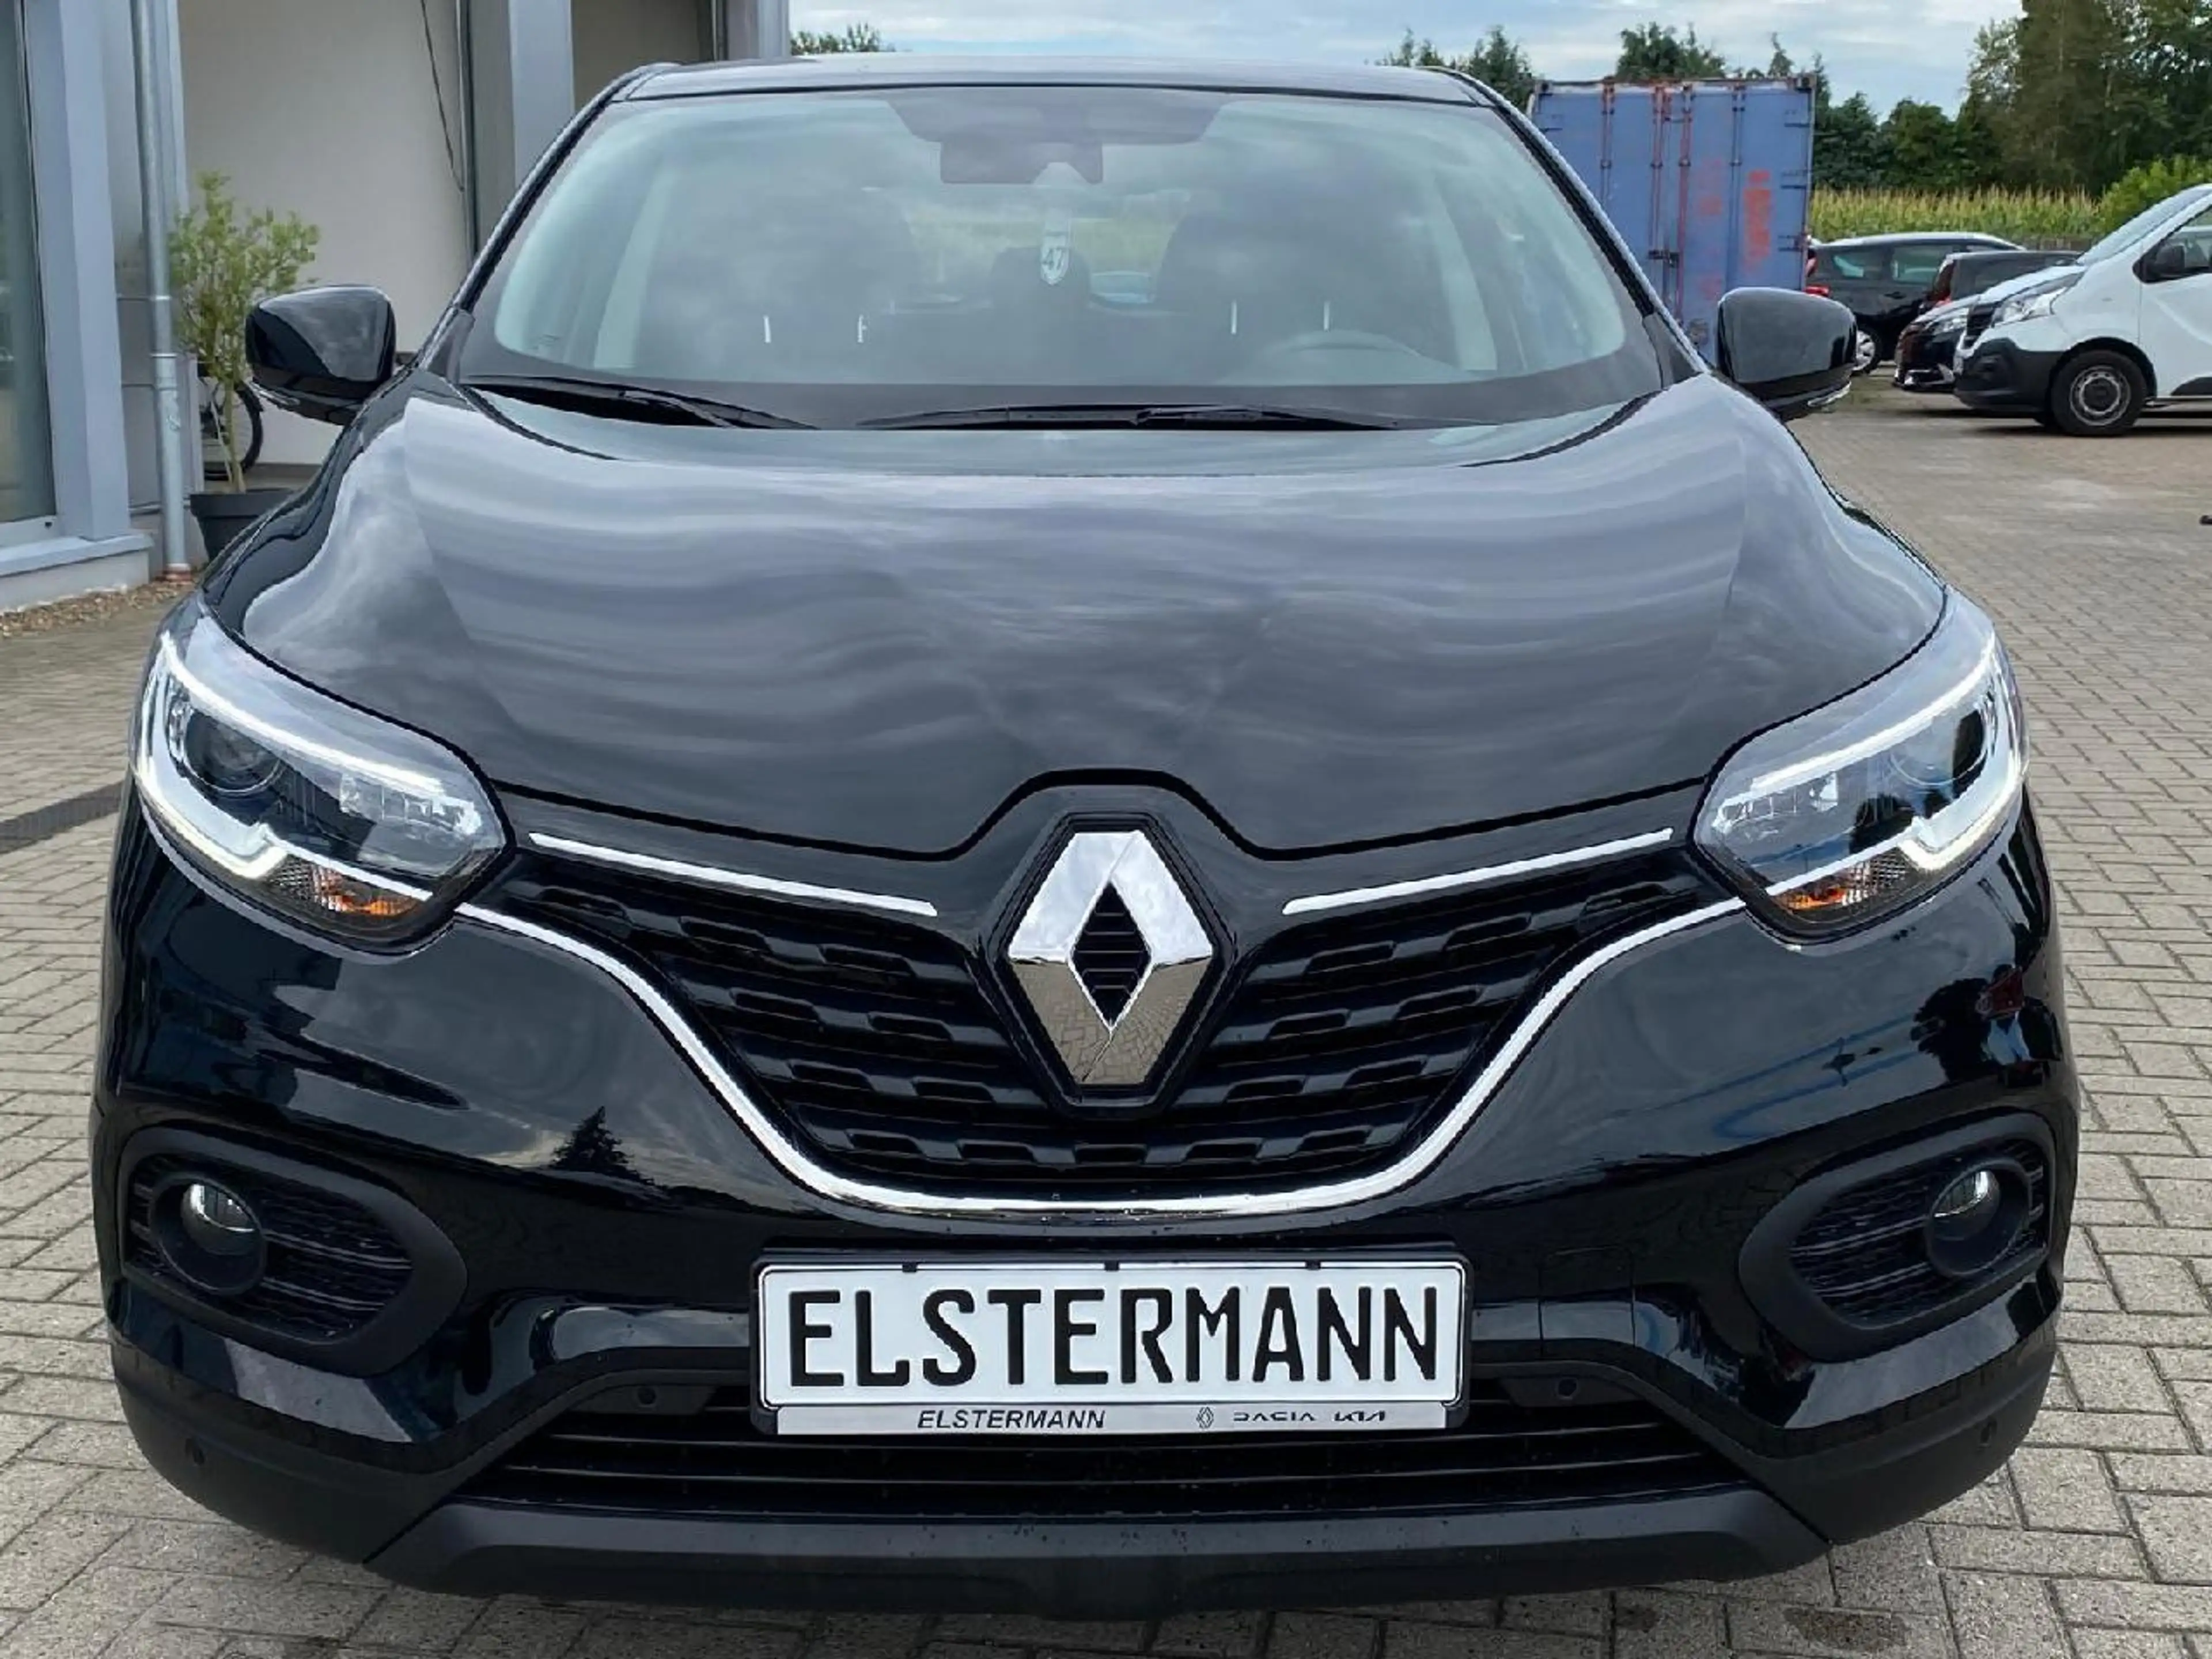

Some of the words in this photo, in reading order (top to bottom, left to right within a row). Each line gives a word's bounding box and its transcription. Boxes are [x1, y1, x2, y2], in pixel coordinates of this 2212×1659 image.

[789, 1286, 1437, 1387] ELSTERMANN
[917, 1409, 1105, 1429] ELSTERMANN
[1233, 1411, 1316, 1422] DACIA
